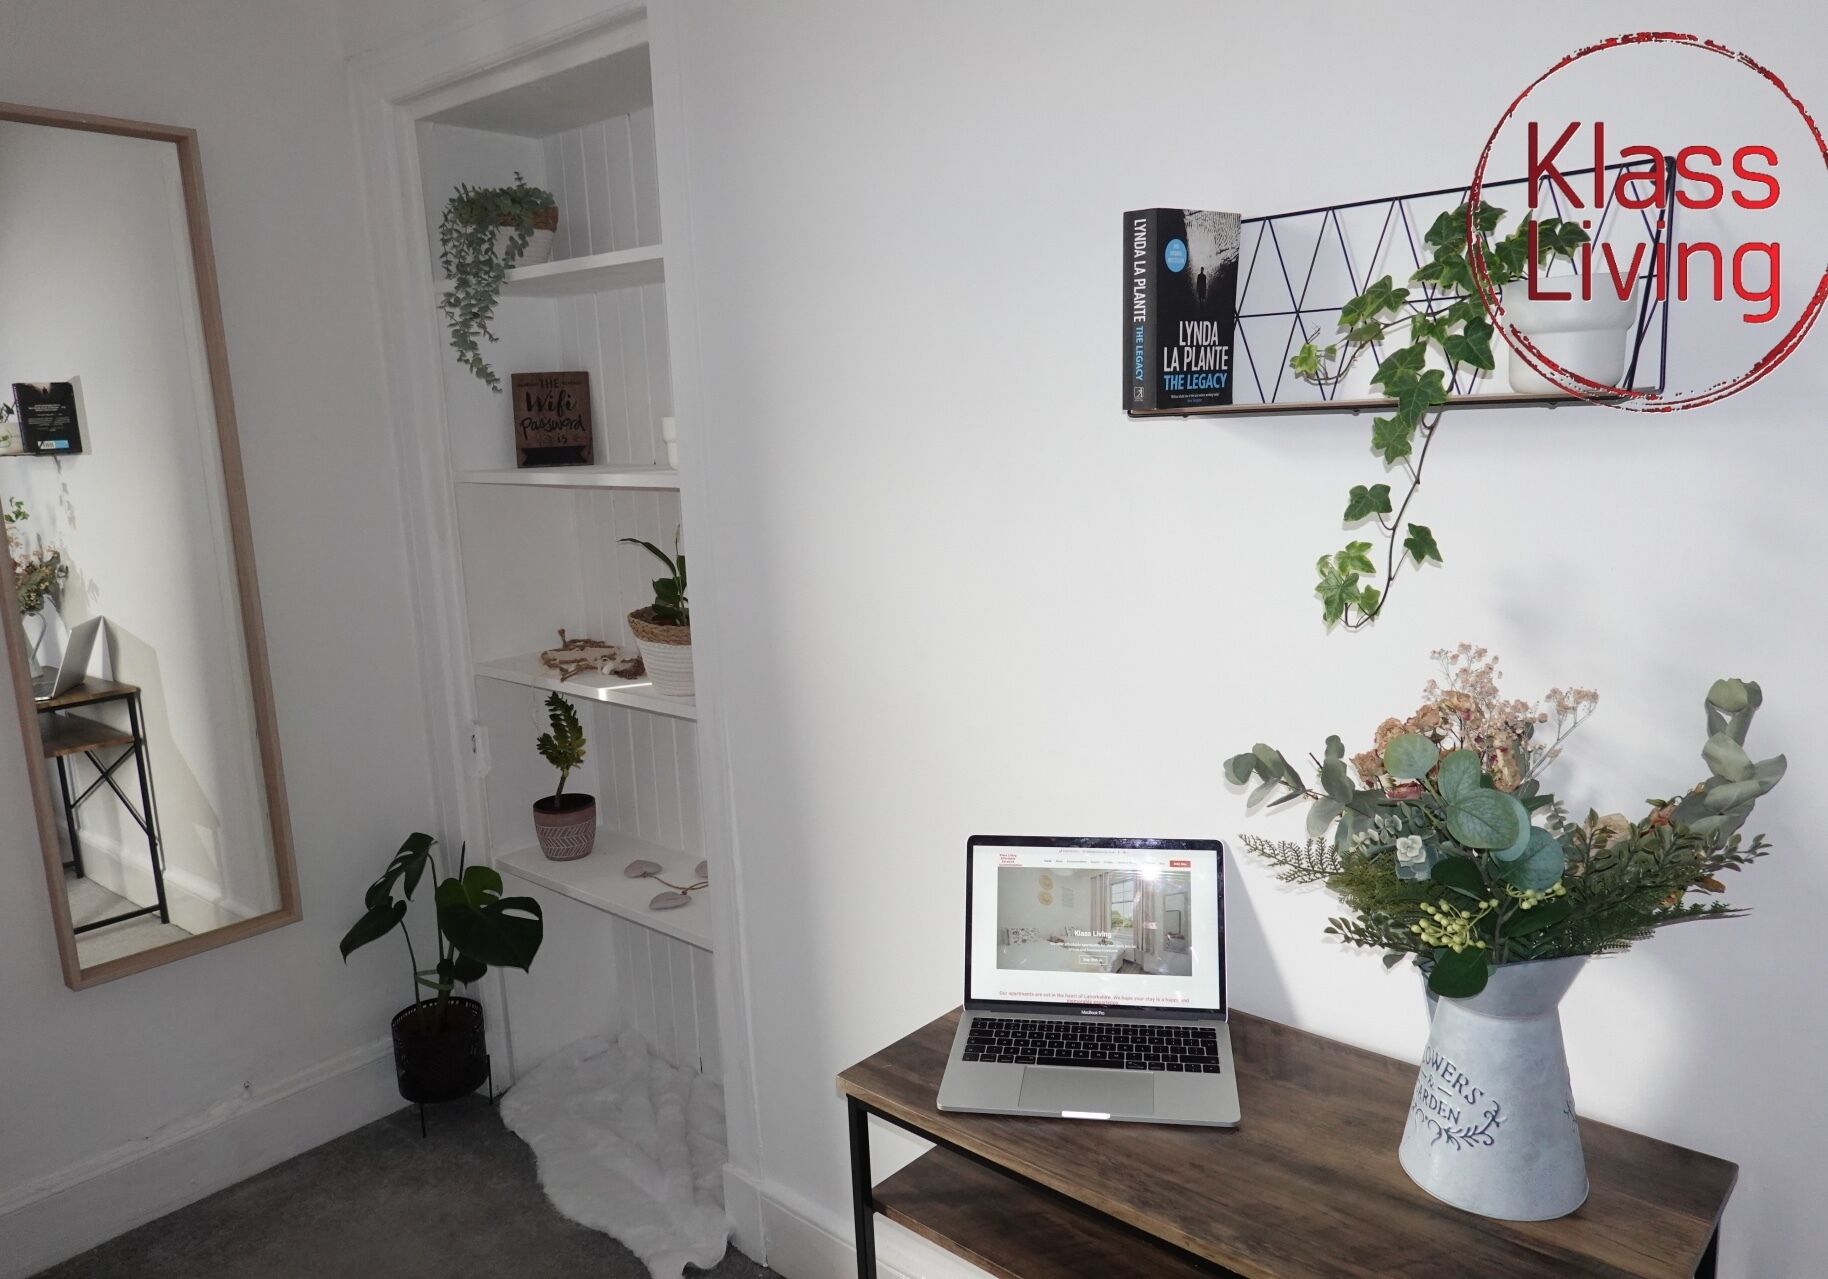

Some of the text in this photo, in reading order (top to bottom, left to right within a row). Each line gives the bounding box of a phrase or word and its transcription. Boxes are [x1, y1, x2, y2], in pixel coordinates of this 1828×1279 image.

[1133, 218, 1146, 259] LYNDA
[1133, 262, 1146, 276] LA
[1133, 278, 1146, 322] PLANTE
[1134, 325, 1144, 343] THE
[1179, 320, 1219, 346] LYNDA
[1134, 345, 1144, 380] LEGACY
[1163, 346, 1228, 372] LA PLANTE
[538, 378, 560, 389] THE
[1163, 372, 1227, 391] THE LEGACY
[525, 389, 577, 417] Wifi
[1092, 930, 1112, 939] Living
[1422, 1046, 1484, 1105] OWERS
